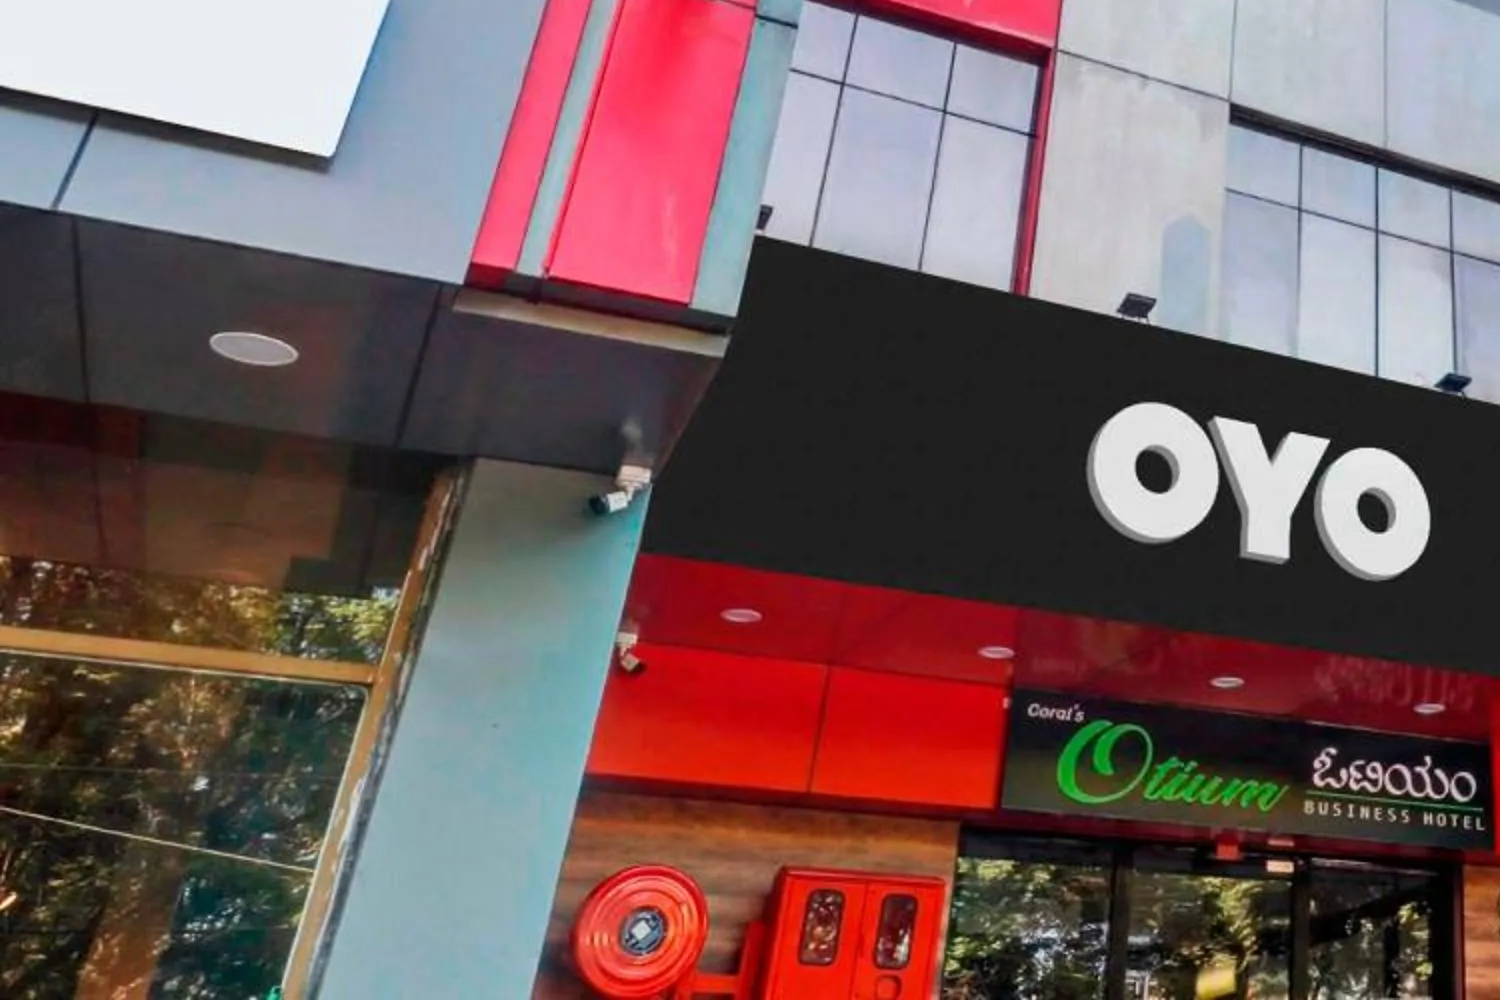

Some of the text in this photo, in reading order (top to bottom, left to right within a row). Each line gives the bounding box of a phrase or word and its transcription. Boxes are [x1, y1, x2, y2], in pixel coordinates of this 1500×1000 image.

[1086, 401, 1431, 581] OYO
[1027, 703, 1085, 723] Coral's
[1057, 719, 1290, 812] Otium
[1312, 747, 1477, 803] ಓಟಿಯಂ
[1303, 801, 1485, 832] BUSINESS HOTEL
